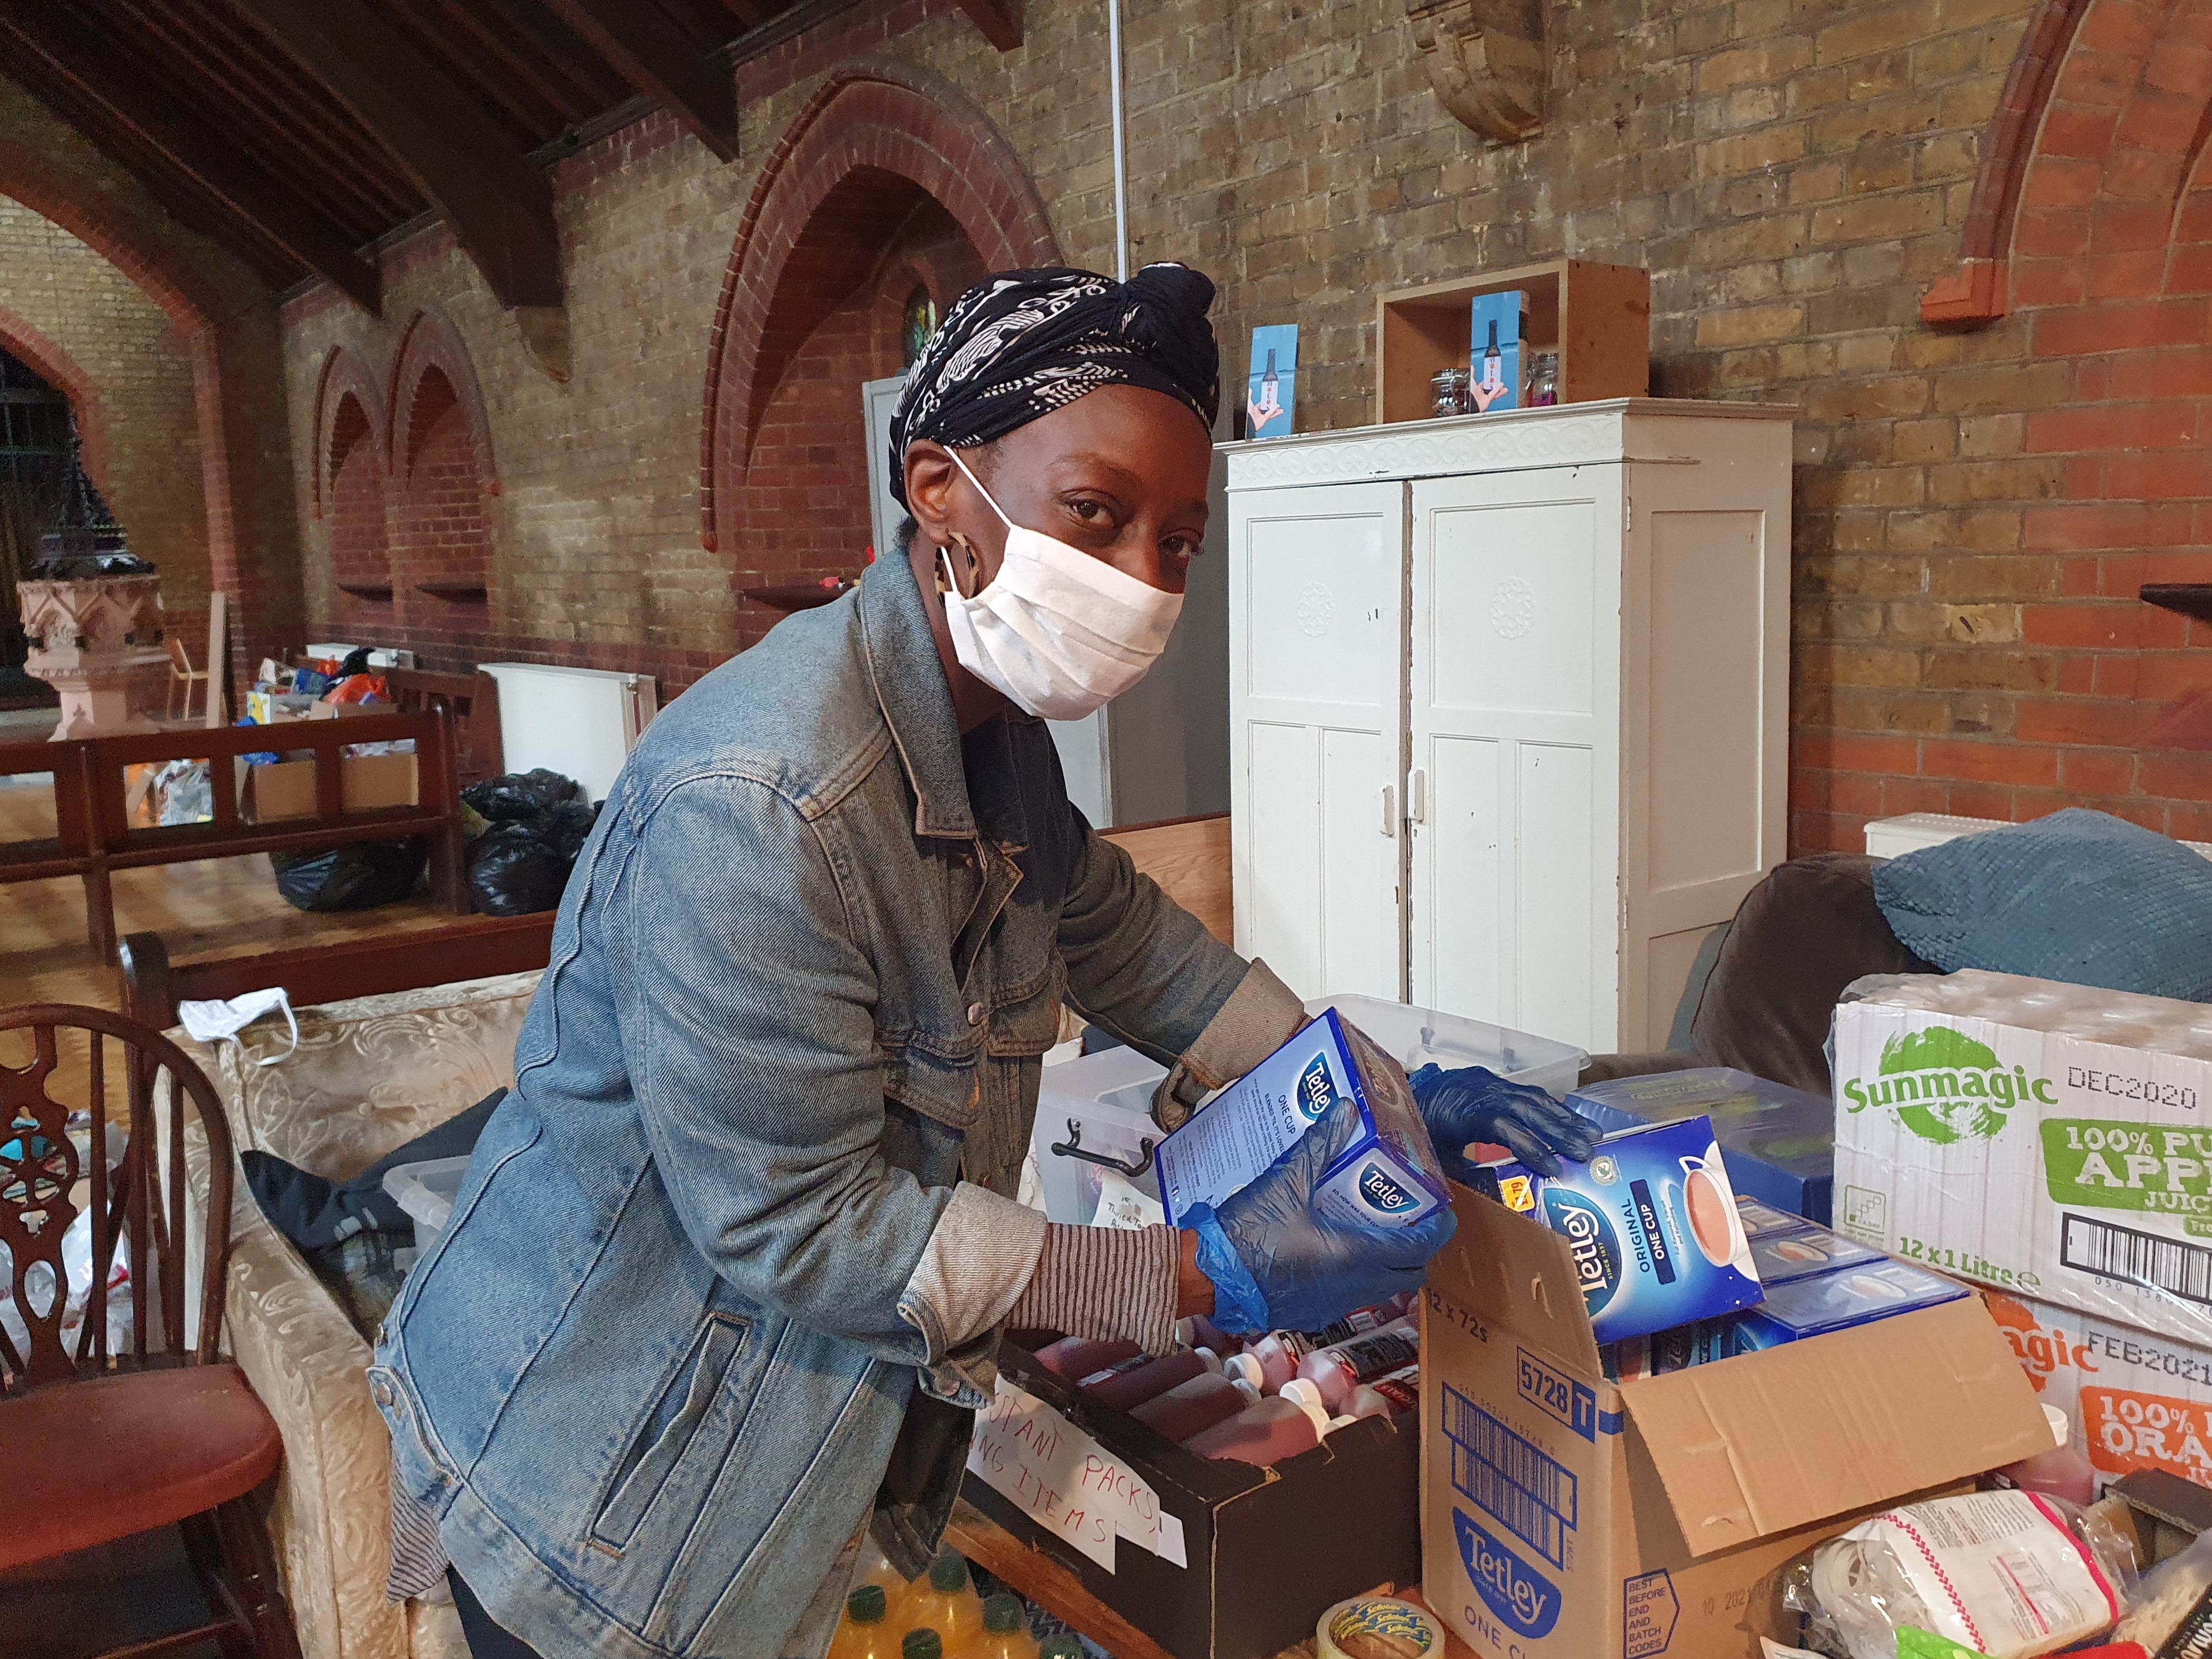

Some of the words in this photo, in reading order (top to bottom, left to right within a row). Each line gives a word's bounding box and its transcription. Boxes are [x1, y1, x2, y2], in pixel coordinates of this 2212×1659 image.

[1279, 1094, 1290, 1116] ONE
[1305, 1062, 1331, 1114] Tetley
[1844, 1064, 2059, 1114] Sunmagic
[2067, 1066, 2196, 1110] DEC2020
[1284, 1116, 1296, 1134] CUP
[2066, 1126, 2154, 1155] 100%
[1365, 1170, 1409, 1209] Tetley
[2145, 1191, 2212, 1214] JUIC
[1621, 1198, 1650, 1273] ORIGINAL
[1641, 1204, 1657, 1229] CUP
[1558, 1203, 1608, 1301] Tetley
[1648, 1230, 1665, 1260] ONE
[1900, 1237, 1923, 1259] 12
[1945, 1249, 1956, 1269] 1
[1961, 1252, 2014, 1285] Litre
[1603, 1258, 1614, 1280] SINCE
[2089, 1331, 2212, 1386] FEB2021
[1521, 1359, 1569, 1414] 5728
[1575, 1391, 1592, 1427] T
[989, 1392, 1064, 1461] STANT
[2099, 1395, 2194, 1434] 100%
[1011, 1463, 1106, 1543] ITEMS
[1465, 1526, 1547, 1625] Tetley
[1629, 1578, 1654, 1592] BEST
[1629, 1587, 1667, 1605] BEFORE
[1629, 1604, 1650, 1617] END
[1464, 1605, 1502, 1650] ONE
[1629, 1617, 1650, 1630] AND
[1629, 1626, 1662, 1643] BATCH
[1629, 1639, 1662, 1655] CODES
